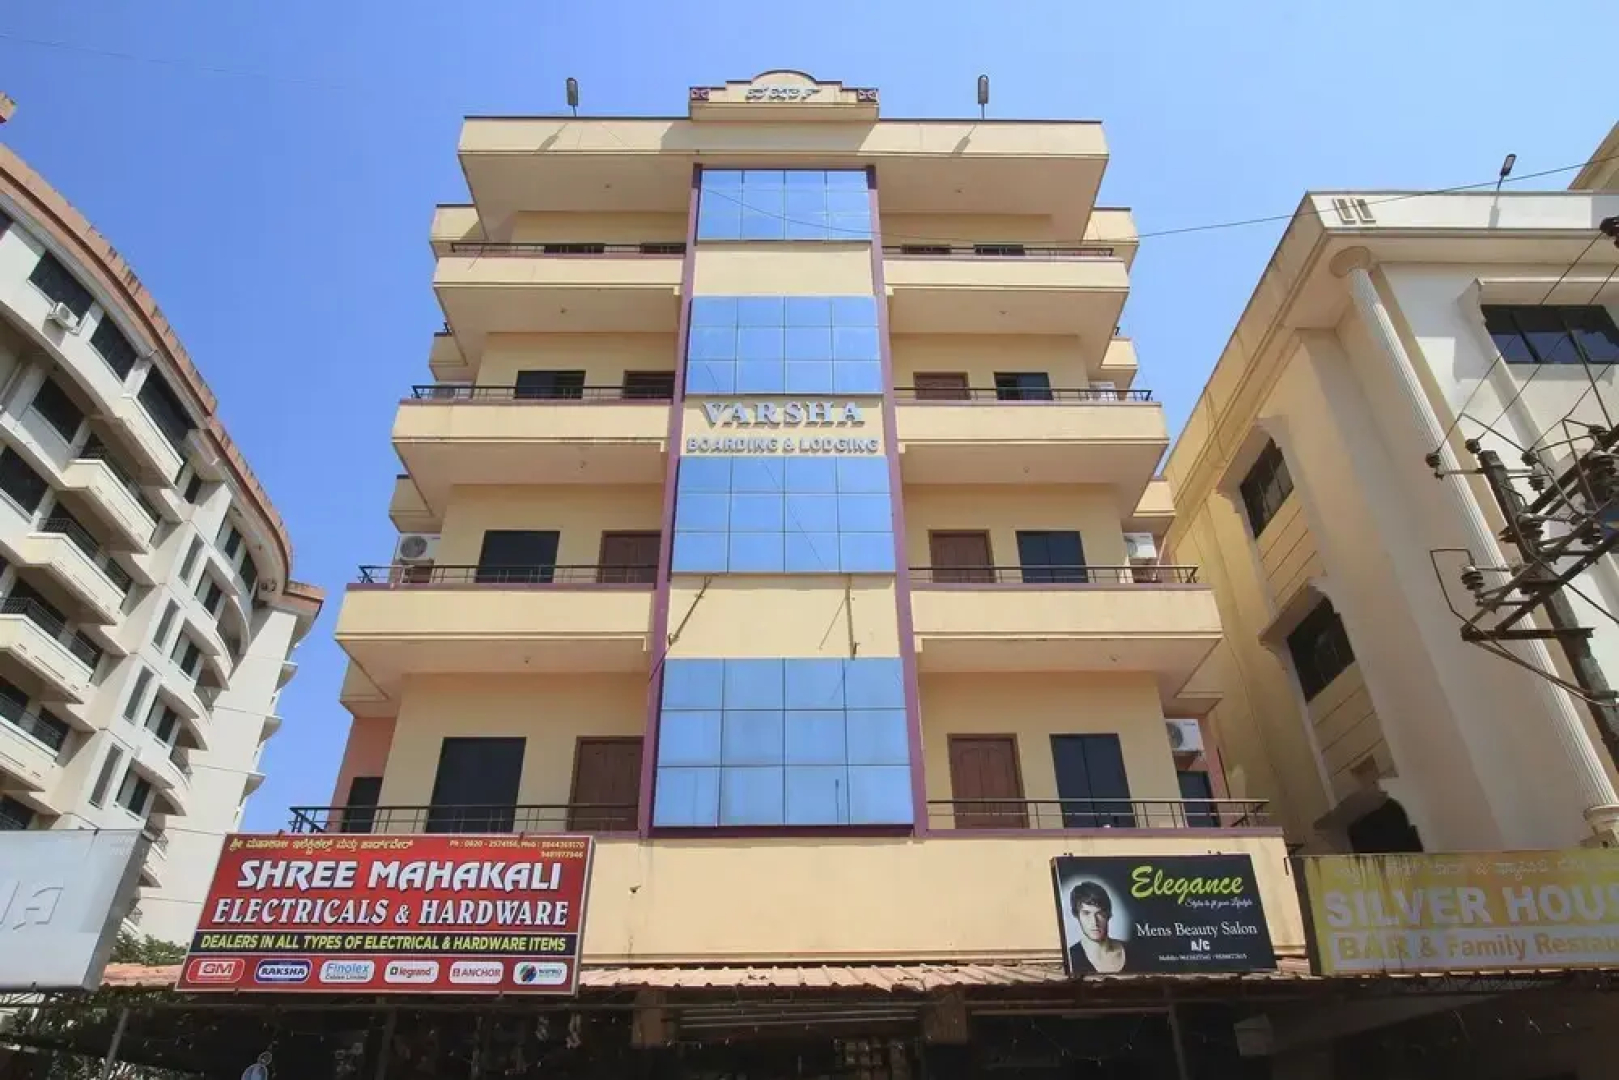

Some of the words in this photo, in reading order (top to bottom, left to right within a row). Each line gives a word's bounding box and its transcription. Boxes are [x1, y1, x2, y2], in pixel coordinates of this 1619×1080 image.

[703, 402, 864, 427] VARSHA
[686, 437, 778, 453] BOARDING
[783, 437, 796, 452] &
[799, 437, 879, 453] LODGING
[237, 860, 357, 891] SHREE
[368, 861, 562, 892] MAHAKALI
[1131, 865, 1244, 904] Elegance
[212, 898, 389, 925] ELECTRICALS
[395, 904, 410, 924] &
[418, 900, 569, 926] HARDWARE
[1326, 886, 1492, 926] SILVER
[1136, 922, 1172, 936] Mens
[1175, 922, 1218, 938] Beauty
[1221, 921, 1258, 935] Salon
[200, 934, 259, 949] DEALERS
[260, 935, 275, 948] IN
[275, 935, 299, 949] ALL
[303, 936, 342, 949] TYPES
[344, 936, 363, 949] OF
[364, 936, 439, 950] ELECTRICAL
[441, 937, 451, 950] &
[453, 937, 526, 951] HARDWARE
[528, 937, 566, 951] ITEMS
[1338, 935, 1411, 960] BAR
[1419, 935, 1437, 958] &
[1449, 932, 1526, 961] Family
[203, 963, 233, 974] GM
[261, 967, 306, 976] RAKSHA
[326, 963, 370, 974] Finolex
[399, 966, 433, 979] legrand
[460, 967, 500, 977] ANCHOR
